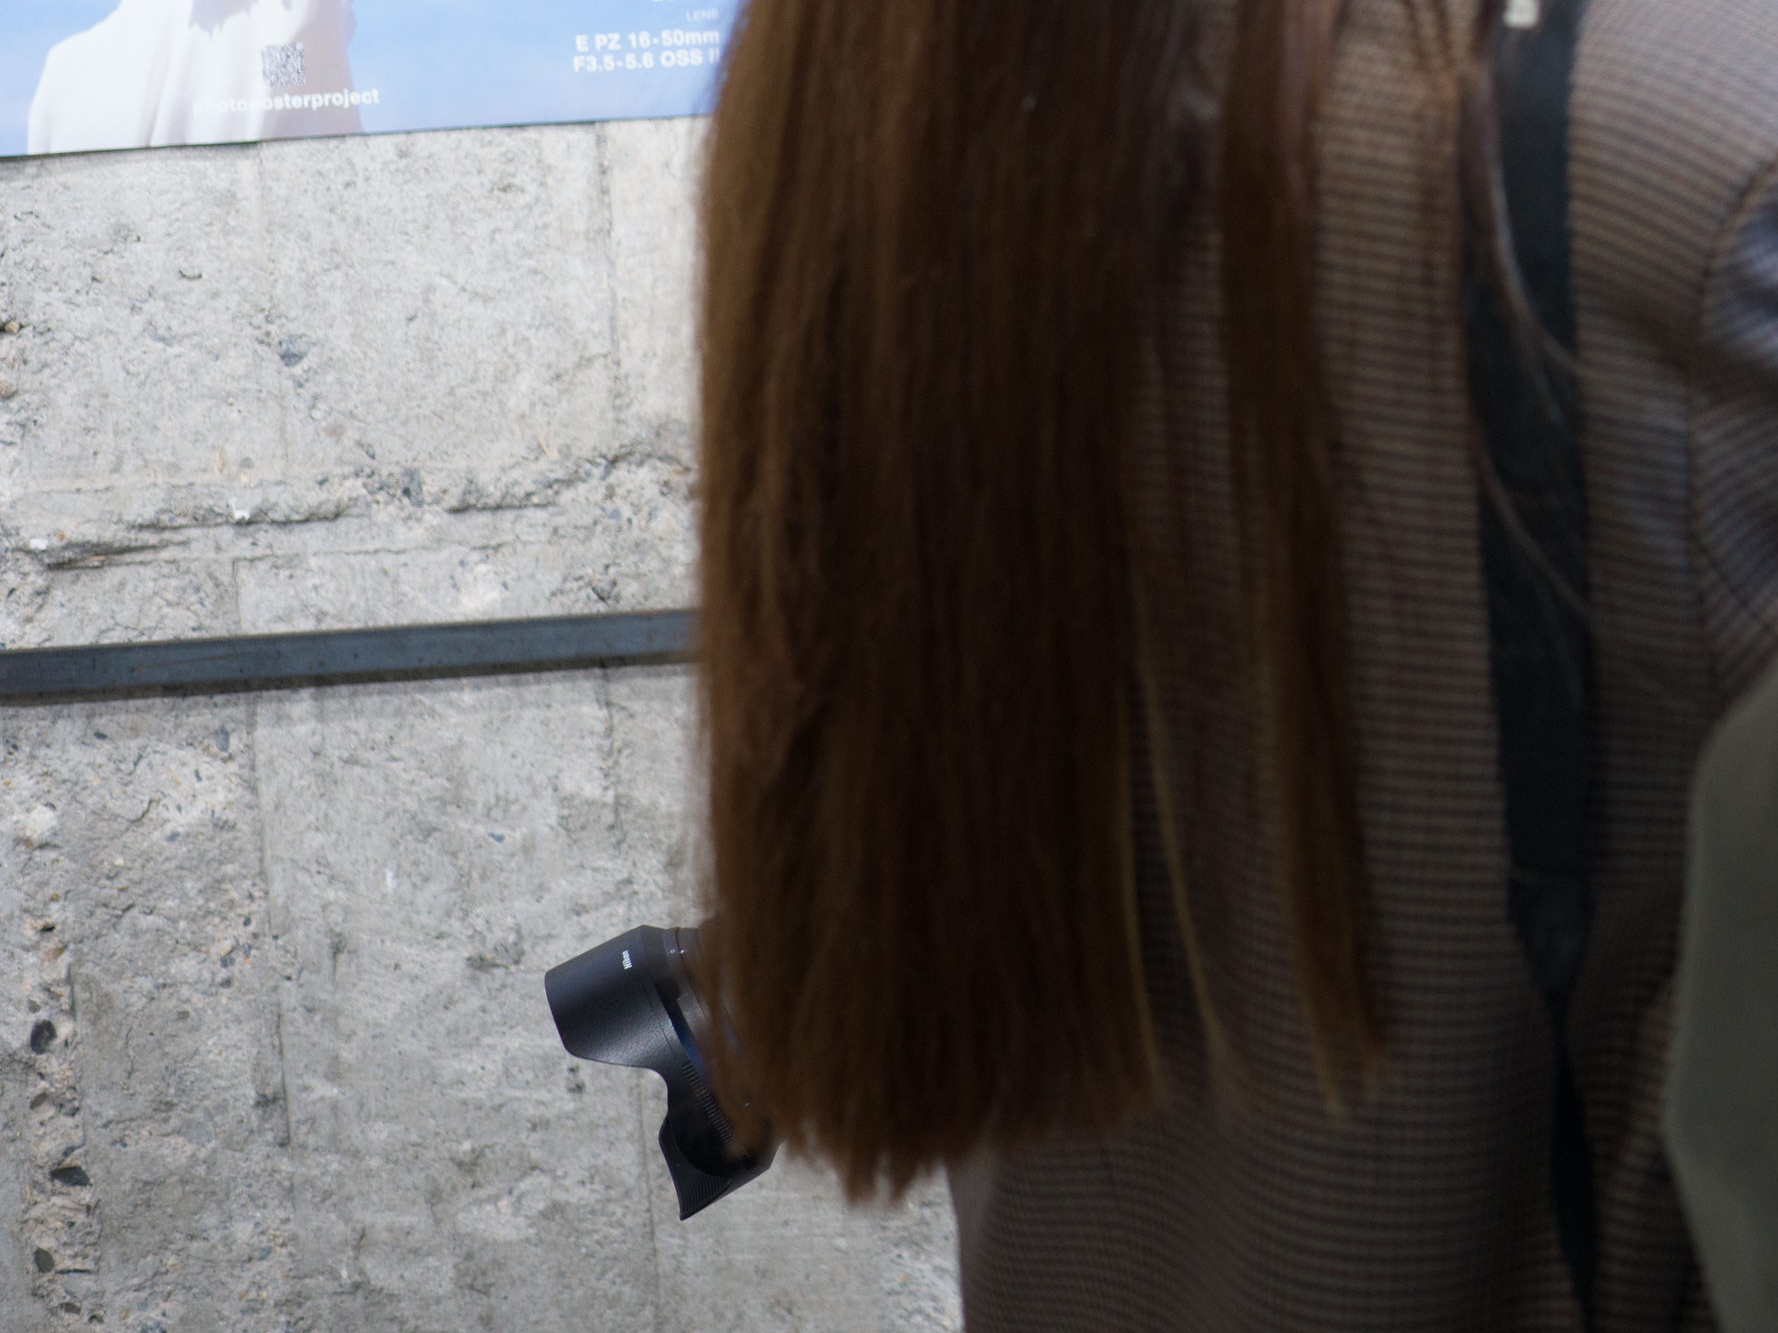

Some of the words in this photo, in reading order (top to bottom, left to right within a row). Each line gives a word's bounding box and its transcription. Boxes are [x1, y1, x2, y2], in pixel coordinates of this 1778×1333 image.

[685, 7, 718, 22] LENS
[576, 34, 589, 52] E
[594, 33, 622, 51] PZ
[627, 28, 720, 49] 16-50mm
[573, 51, 654, 72] F3.5-5.6
[660, 48, 703, 68] OSS
[192, 88, 380, 115] photoposterproject
